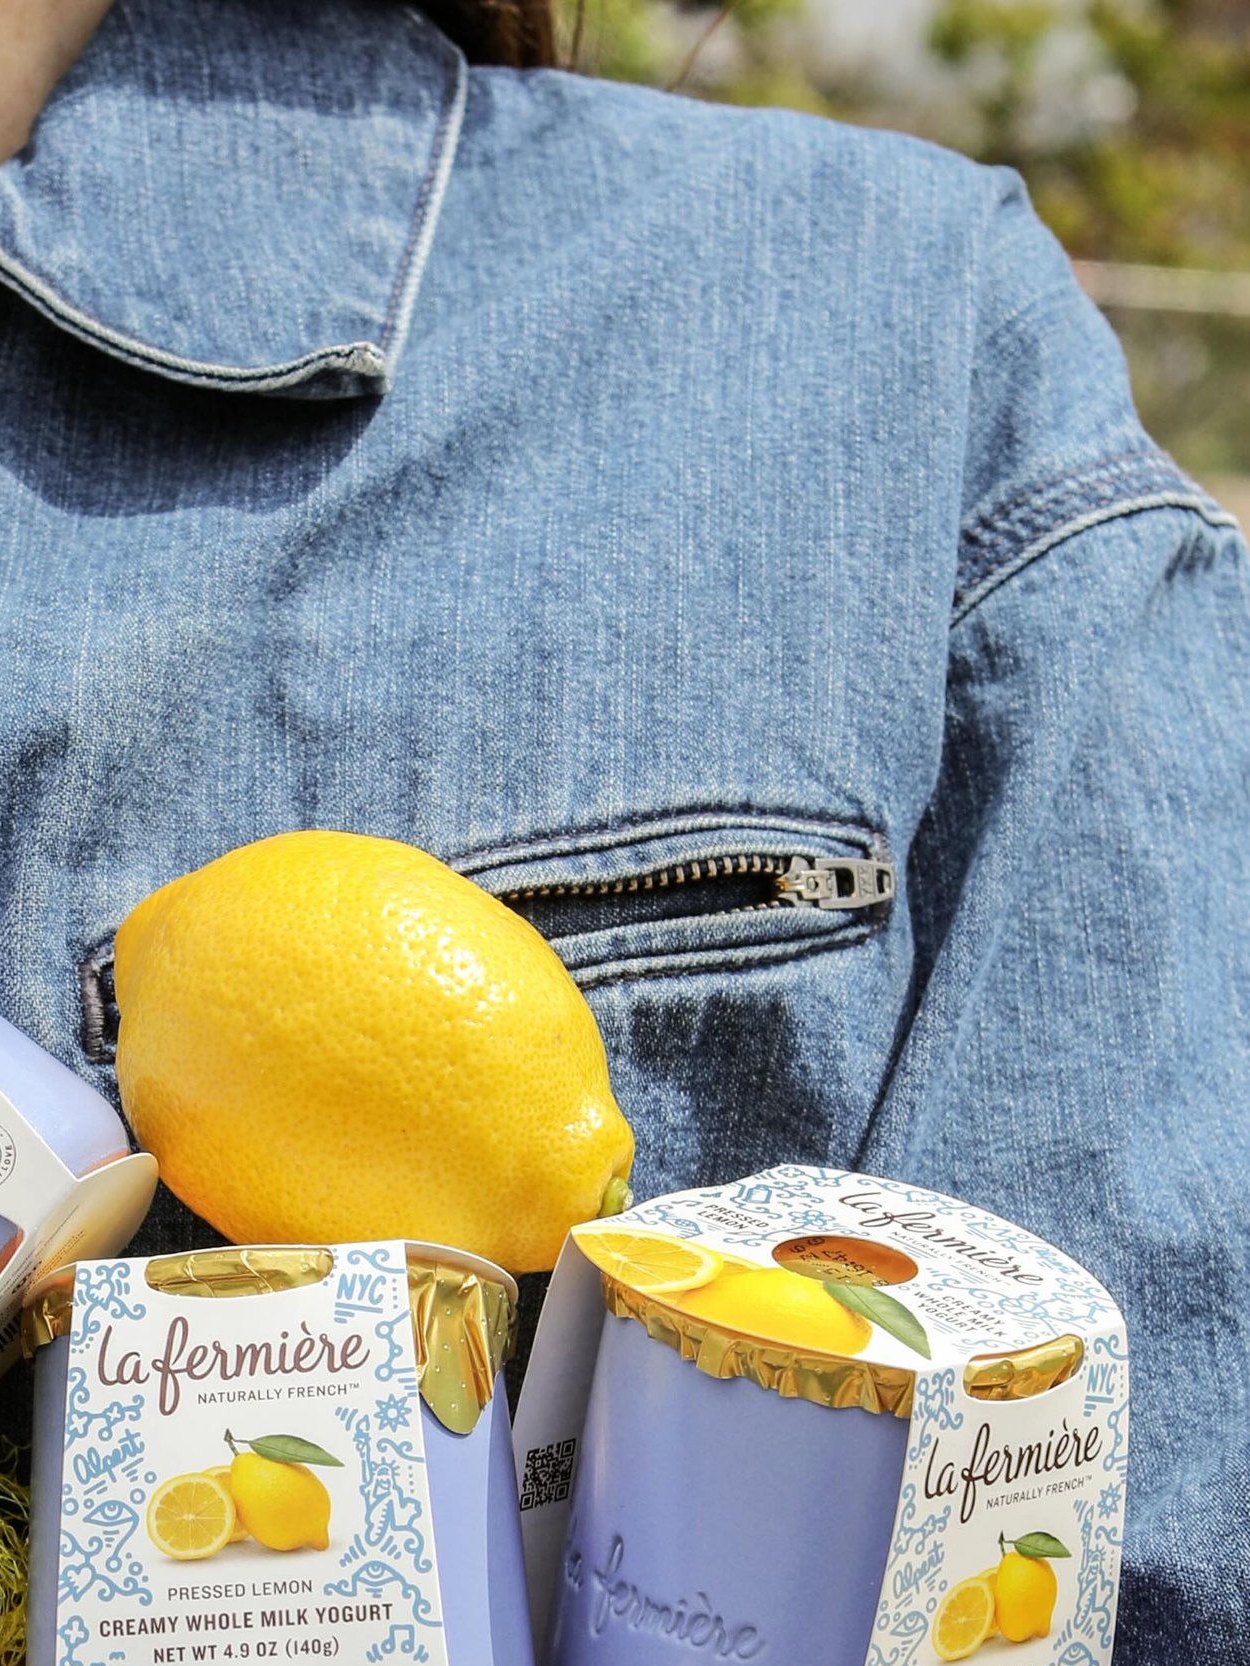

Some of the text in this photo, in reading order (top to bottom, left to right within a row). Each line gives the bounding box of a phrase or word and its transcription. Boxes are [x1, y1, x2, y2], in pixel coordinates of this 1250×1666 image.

[1, 1145, 12, 1171] LOVE
[697, 1210, 749, 1230] LEMON
[705, 1204, 770, 1228] PRESSED
[839, 1192, 1044, 1286] la fermière
[891, 1231, 954, 1261] NATURALLY
[336, 1273, 387, 1305] NYC
[913, 1290, 1009, 1338] WHOLE MILK
[917, 1302, 980, 1333] YOGURT
[942, 1295, 1006, 1326] CREAMY
[97, 1316, 370, 1416] la fermière
[1086, 1364, 1118, 1395] NYC
[197, 1387, 282, 1405] NATURALLY
[924, 1418, 1103, 1524] la fermière
[986, 1485, 1044, 1510] NATURALLY
[168, 1579, 313, 1601] PRESSED LEMON
[99, 1603, 394, 1638] CREAMY WHOLE MILK YOGURT
[154, 1635, 340, 1664] NET WT 4.9 OZ (140g)
